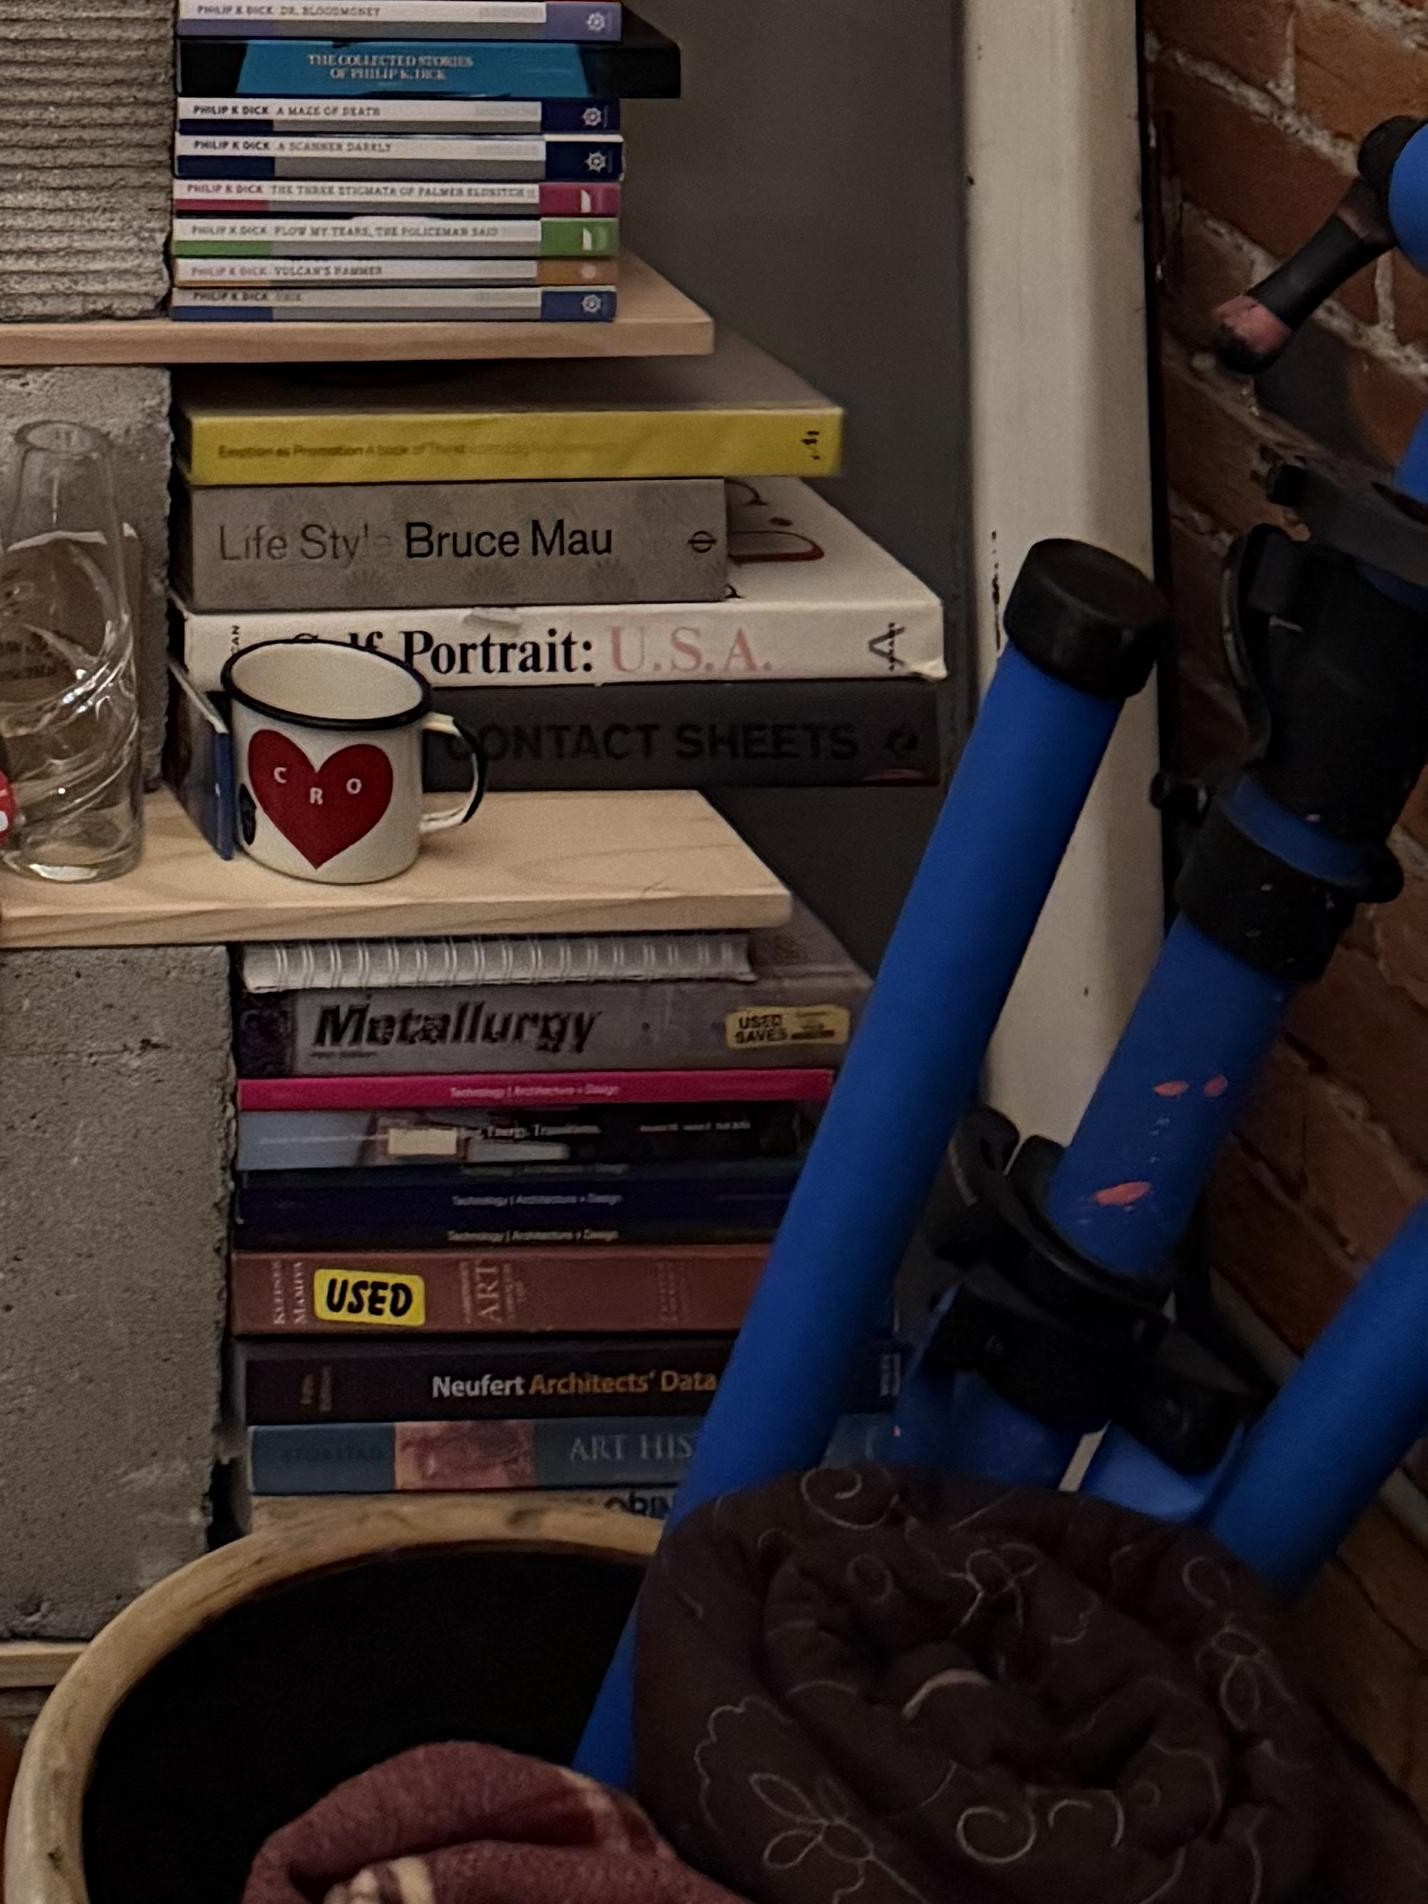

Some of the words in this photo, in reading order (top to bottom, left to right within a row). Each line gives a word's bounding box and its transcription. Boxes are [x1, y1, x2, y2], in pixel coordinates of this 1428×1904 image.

[406, 524, 519, 559] Bruce
[532, 520, 612, 557] Mau
[404, 630, 593, 674] Portrait:
[610, 626, 771, 674] U.S.A.
[314, 1000, 599, 1052] Metallurgy
[325, 1281, 413, 1317] USED
[432, 1375, 524, 1398] Neufert
